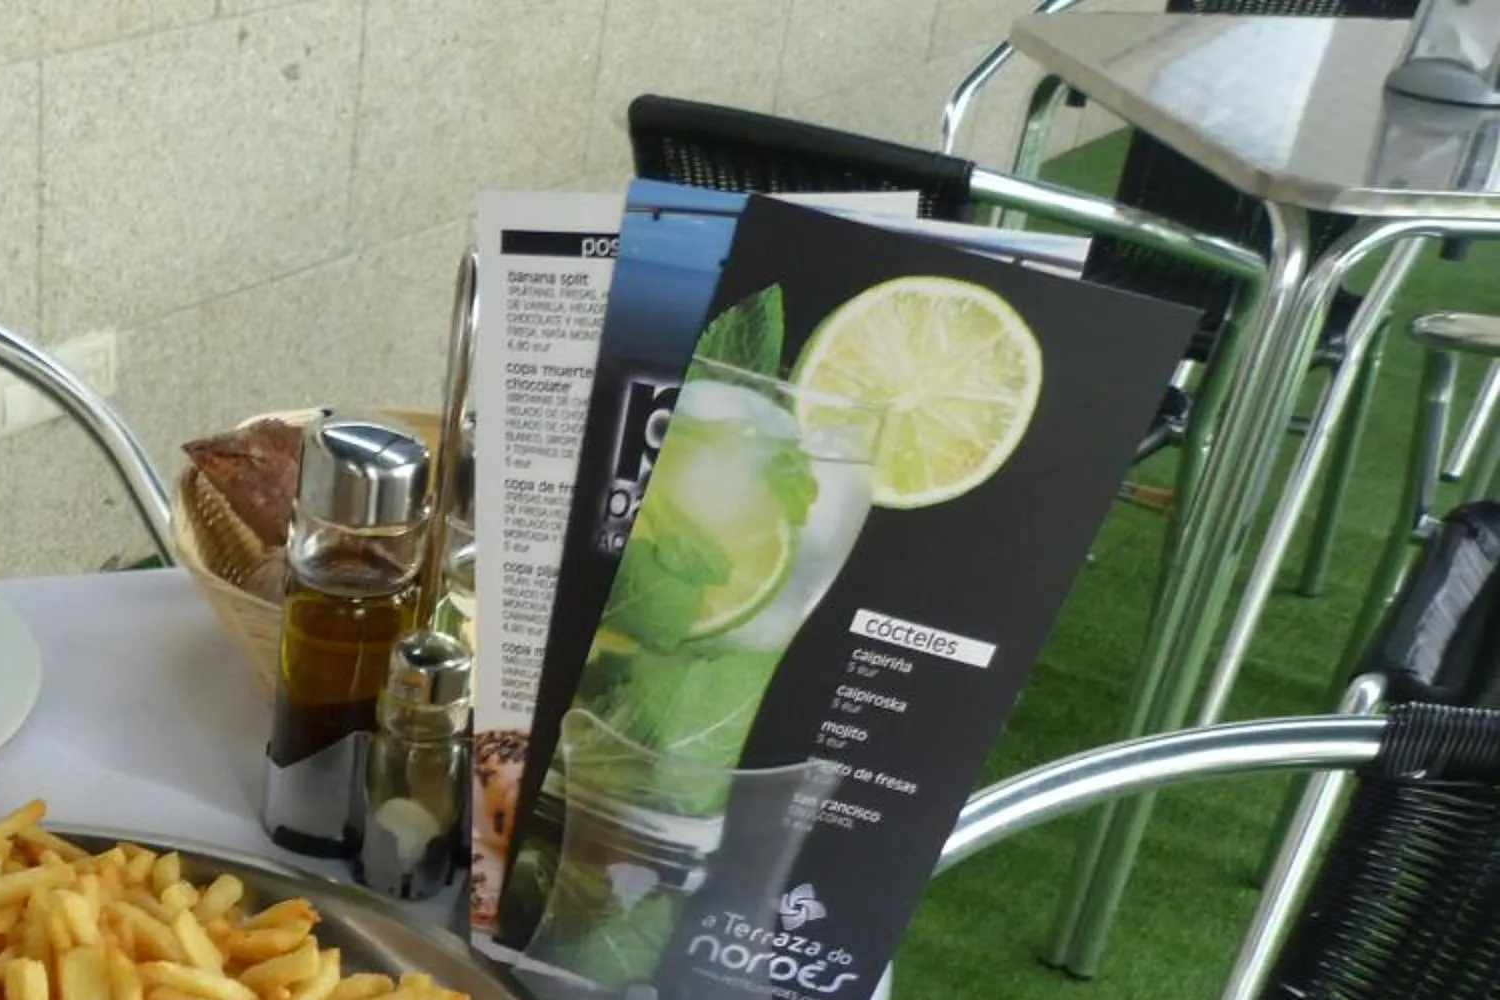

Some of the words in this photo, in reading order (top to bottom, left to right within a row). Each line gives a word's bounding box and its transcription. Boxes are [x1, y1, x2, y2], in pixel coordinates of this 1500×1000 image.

[507, 271, 555, 284] banana
[560, 273, 589, 286] split
[506, 362, 537, 377] copa
[504, 478, 534, 492] copa
[538, 480, 555, 493] de
[503, 562, 533, 577] copa
[866, 618, 958, 656] cócteles
[836, 684, 908, 713] caipiroska
[821, 720, 868, 742] mojito
[853, 767, 873, 782] de
[875, 772, 917, 795] fresas
[817, 799, 881, 823] rancisco
[702, 914, 717, 928] a
[724, 911, 821, 956] Terraza
[828, 947, 853, 966] do
